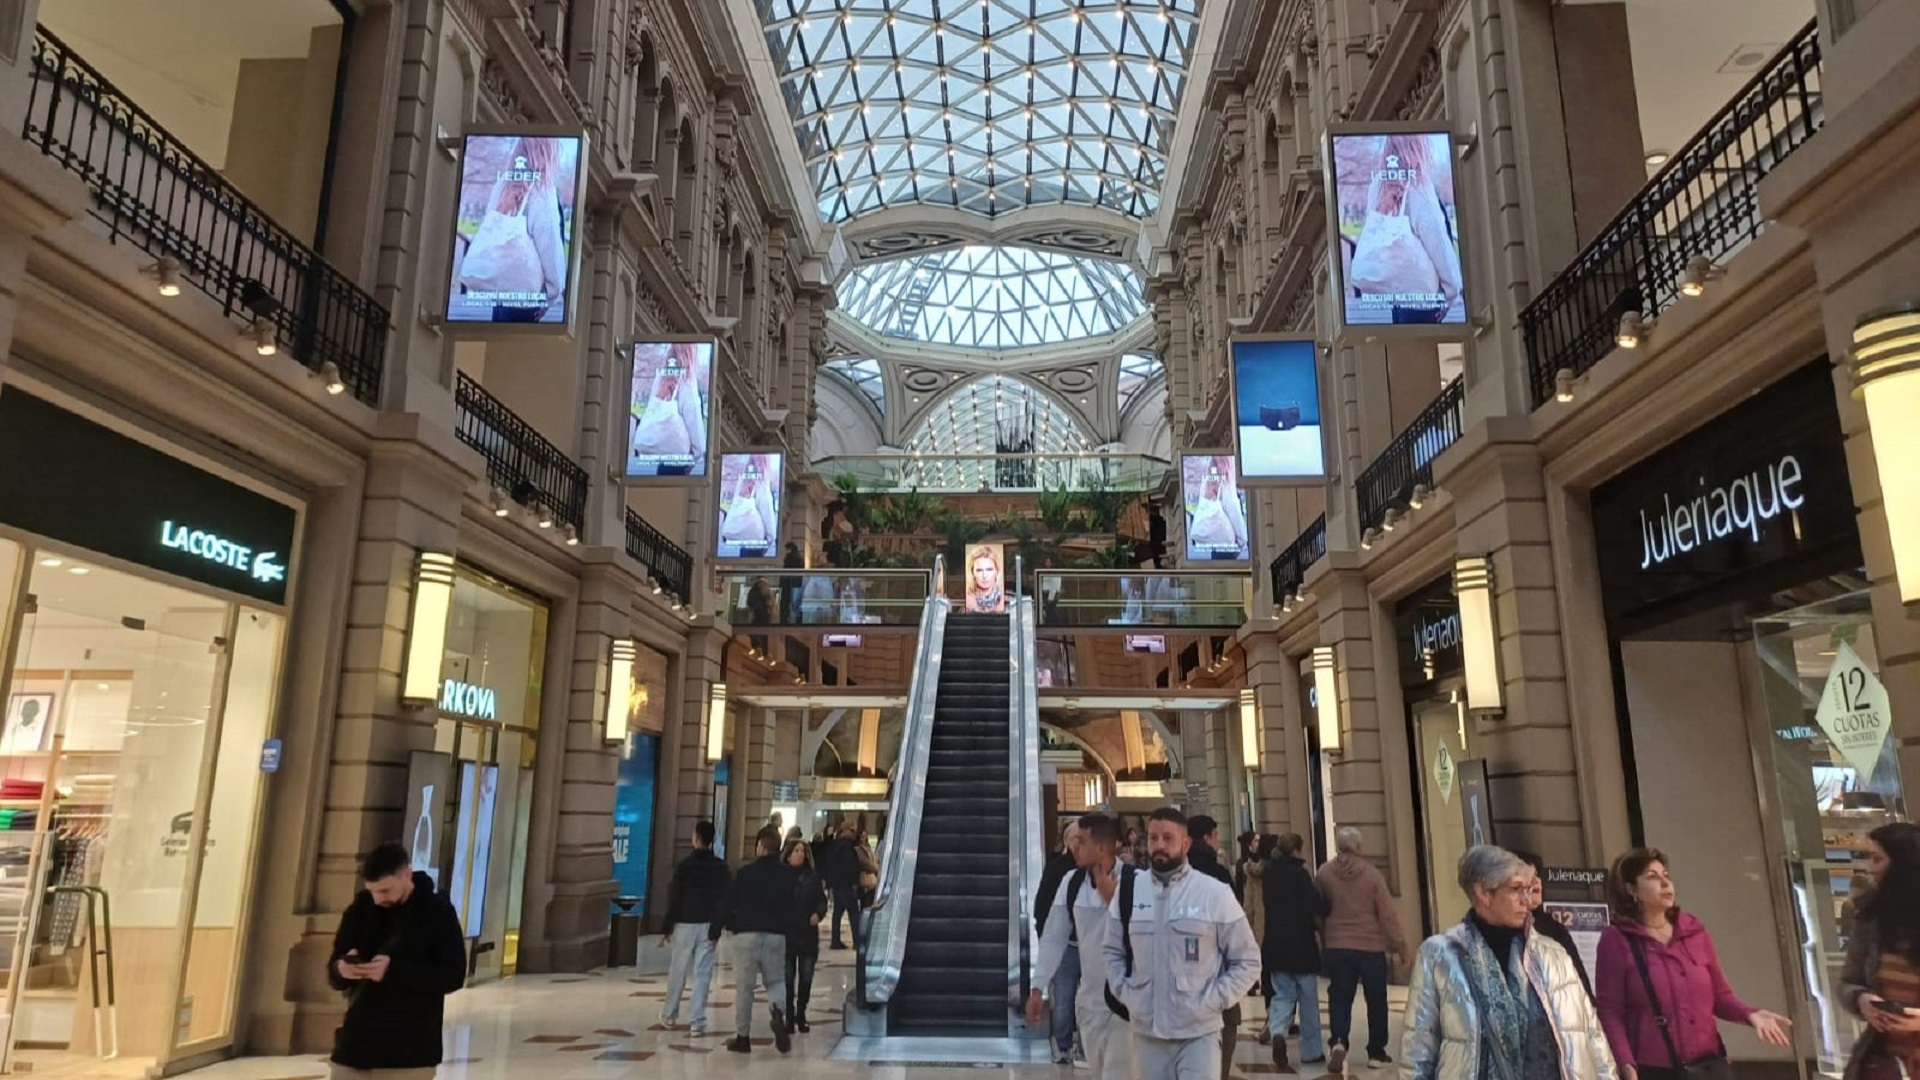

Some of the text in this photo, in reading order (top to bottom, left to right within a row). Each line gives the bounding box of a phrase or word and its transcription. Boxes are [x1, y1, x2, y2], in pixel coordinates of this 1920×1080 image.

[497, 171, 541, 182] LEDER
[1371, 169, 1417, 180] LEDER
[1640, 455, 1804, 569] Juleriaque
[162, 520, 251, 571] LACOSTE
[438, 679, 495, 719] RKOVA
[1838, 667, 1871, 713] 12
[1834, 712, 1880, 734] CUOTAS
[1547, 869, 1604, 884] Juleriaque
